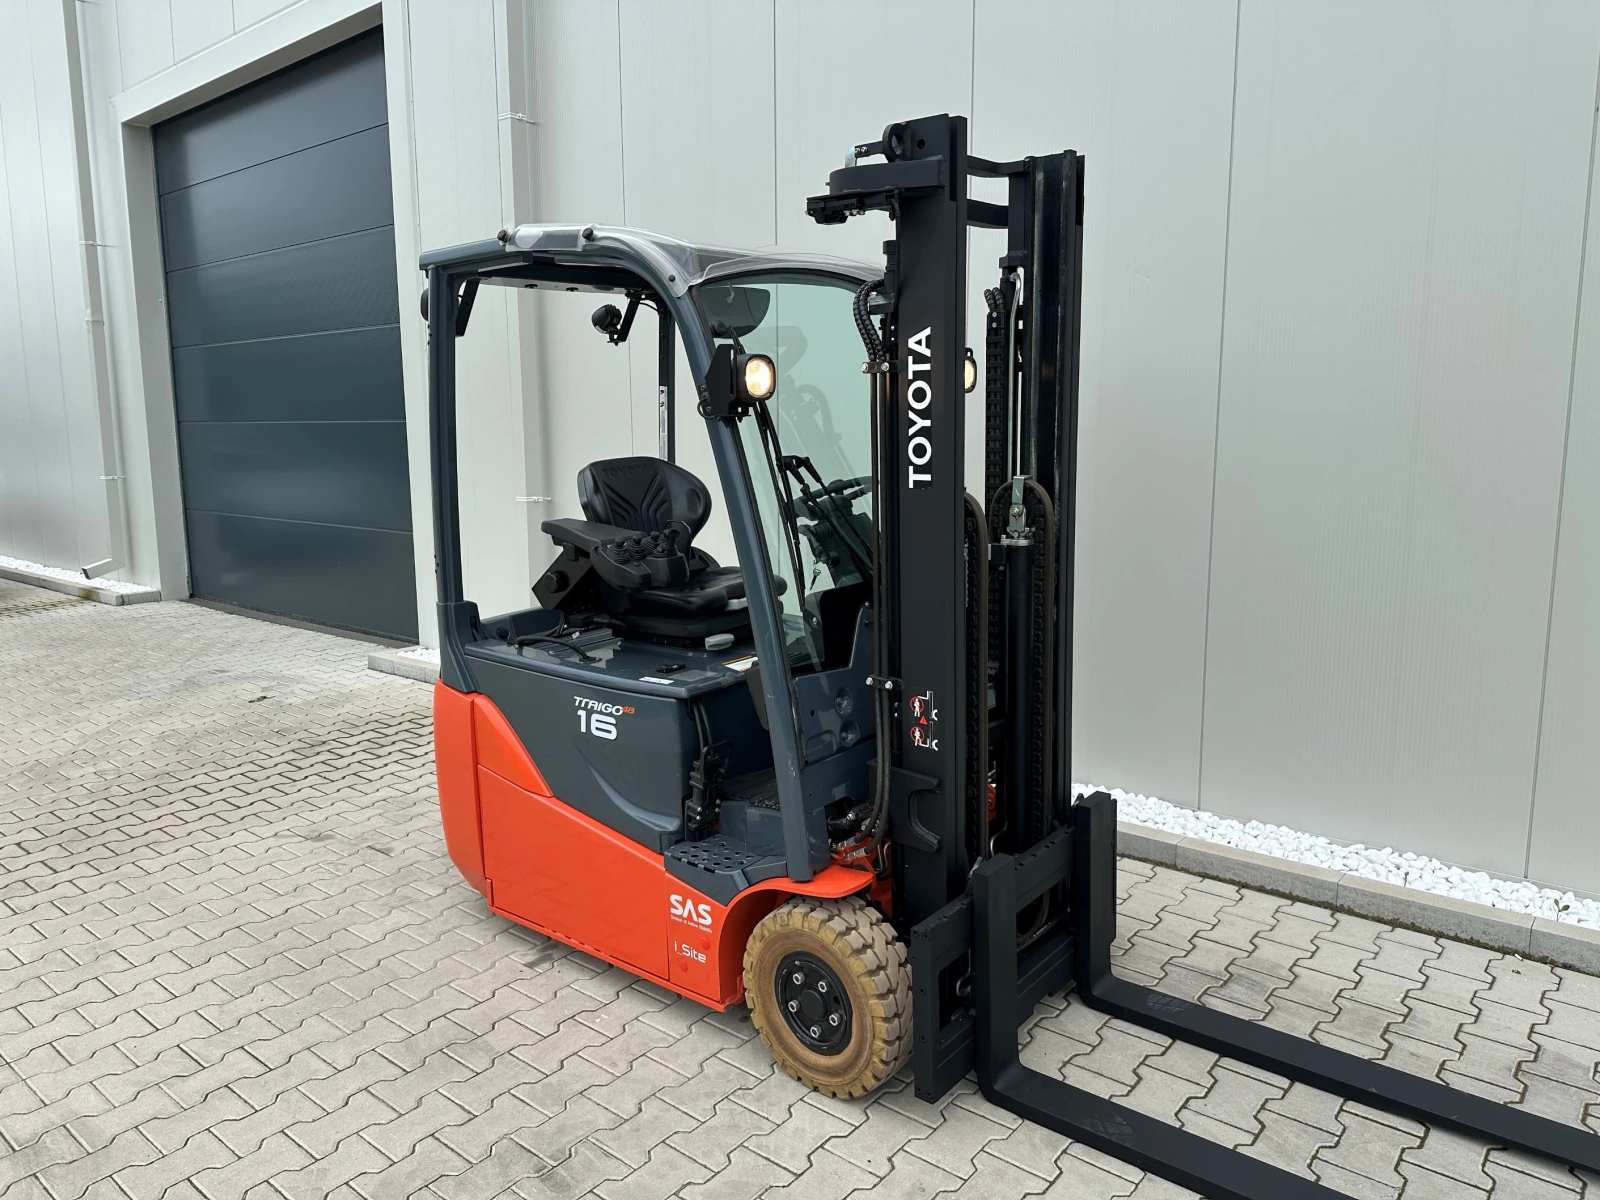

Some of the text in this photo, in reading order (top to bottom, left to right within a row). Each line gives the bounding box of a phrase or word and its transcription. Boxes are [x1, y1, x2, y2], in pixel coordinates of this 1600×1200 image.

[907, 326, 932, 488] TOYOTA
[601, 463, 653, 479] TOYOT
[577, 709, 617, 740] 16
[669, 894, 712, 925] SAS
